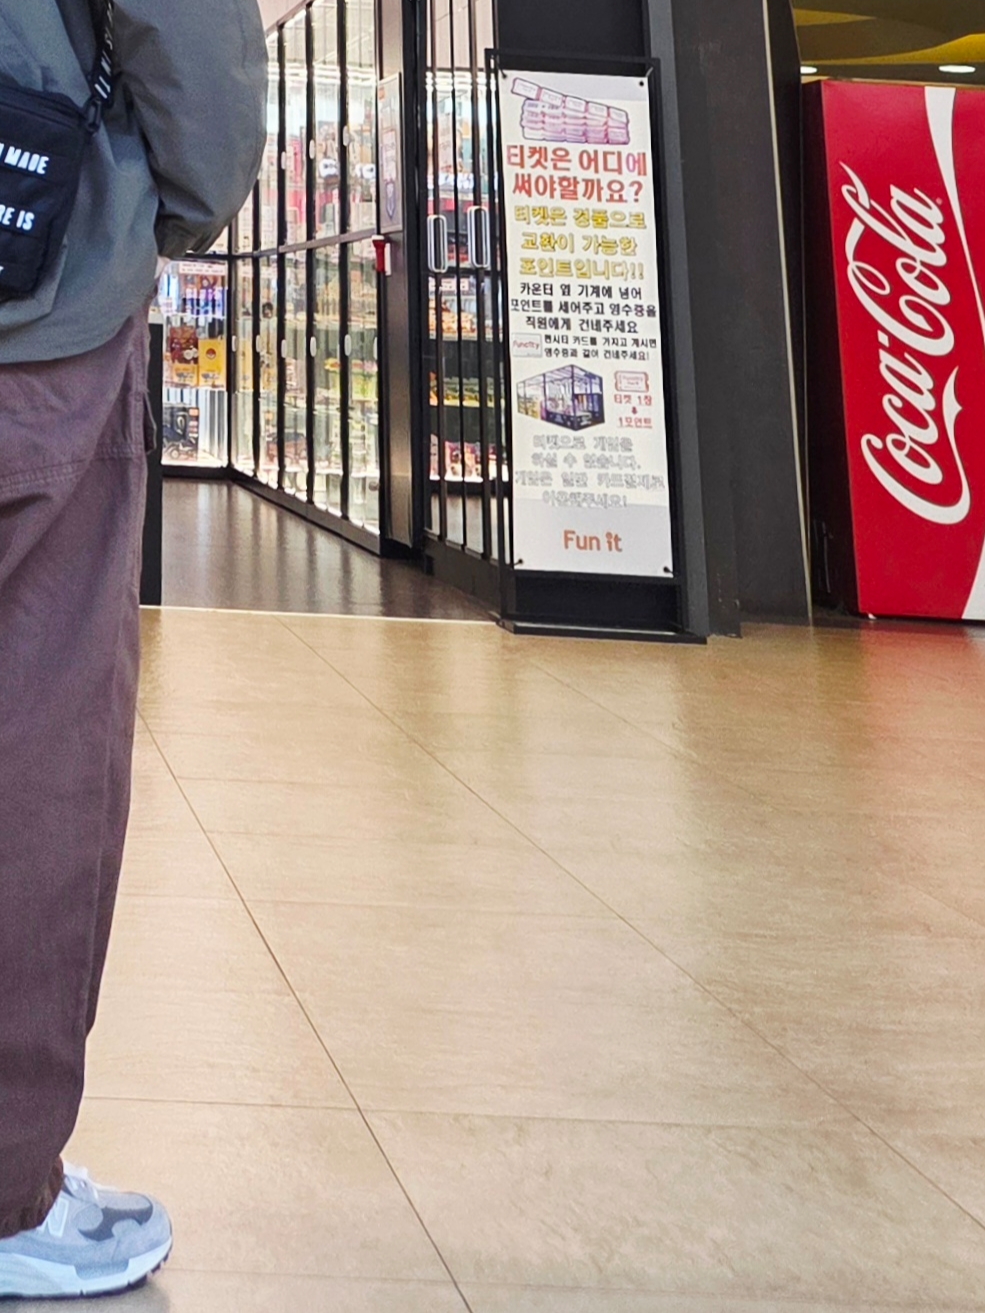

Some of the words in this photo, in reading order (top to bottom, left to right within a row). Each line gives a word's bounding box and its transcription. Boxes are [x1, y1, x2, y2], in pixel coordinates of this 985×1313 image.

[507, 145, 572, 171] 티켓은
[579, 149, 647, 176] 어디에
[513, 173, 643, 203] 써야할까요?
[15, 211, 36, 231] IS
[515, 206, 567, 226] 티켓은
[573, 207, 647, 229] 경품으로
[521, 231, 574, 254] 교환이
[582, 234, 637, 256] 가능한
[520, 282, 553, 297] 카운터
[578, 284, 613, 299] 기계에
[525, 315, 572, 331] 직원에게
[579, 318, 638, 334] 건네주세요
[840, 160, 970, 525] Coca-Cola
[563, 530, 601, 551] Fun
[605, 532, 623, 553] it
